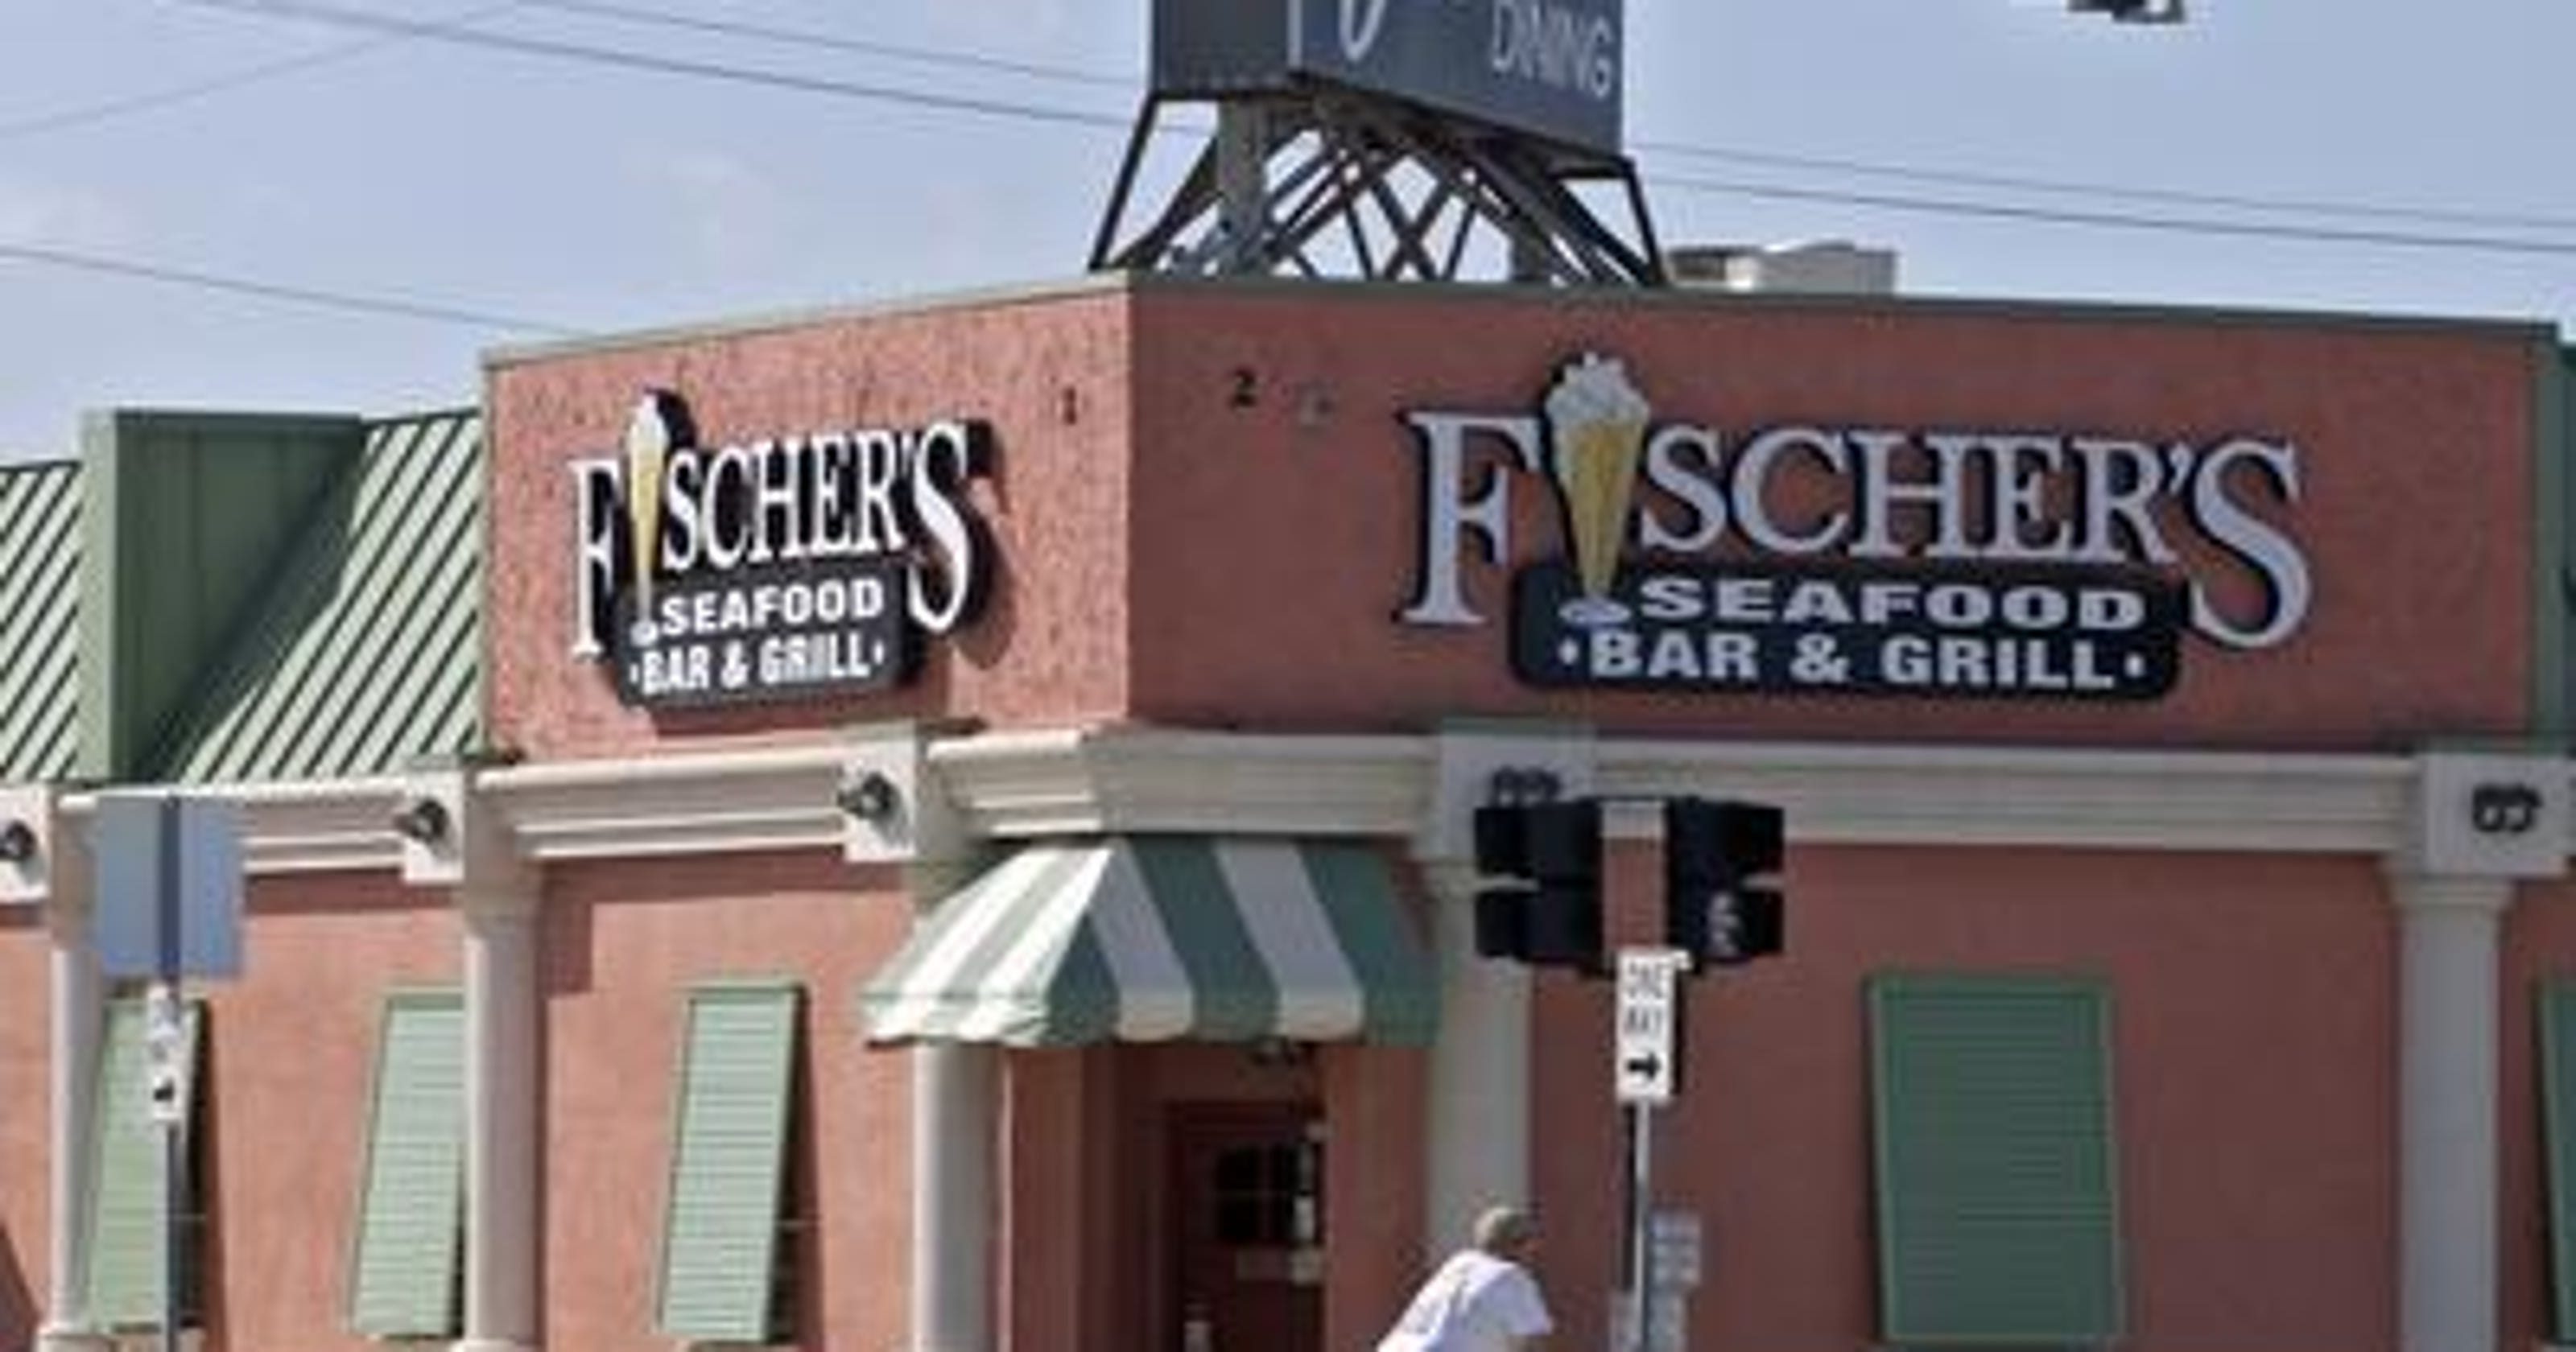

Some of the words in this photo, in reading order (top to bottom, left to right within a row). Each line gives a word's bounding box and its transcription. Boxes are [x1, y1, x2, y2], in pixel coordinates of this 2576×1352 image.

[1492, 0, 1612, 100] DINING
[569, 394, 971, 656] FISCHER'S
[1402, 352, 2310, 648] FISCHER'S
[660, 577, 884, 637] SEAFOOD
[1639, 577, 2145, 630] SEAFOOD
[643, 645, 710, 695] BAR
[720, 645, 749, 689] &
[758, 631, 872, 685] GRILL
[1591, 631, 1759, 679] BAR
[1790, 634, 1850, 684] &
[1880, 635, 2116, 689] GRILL
